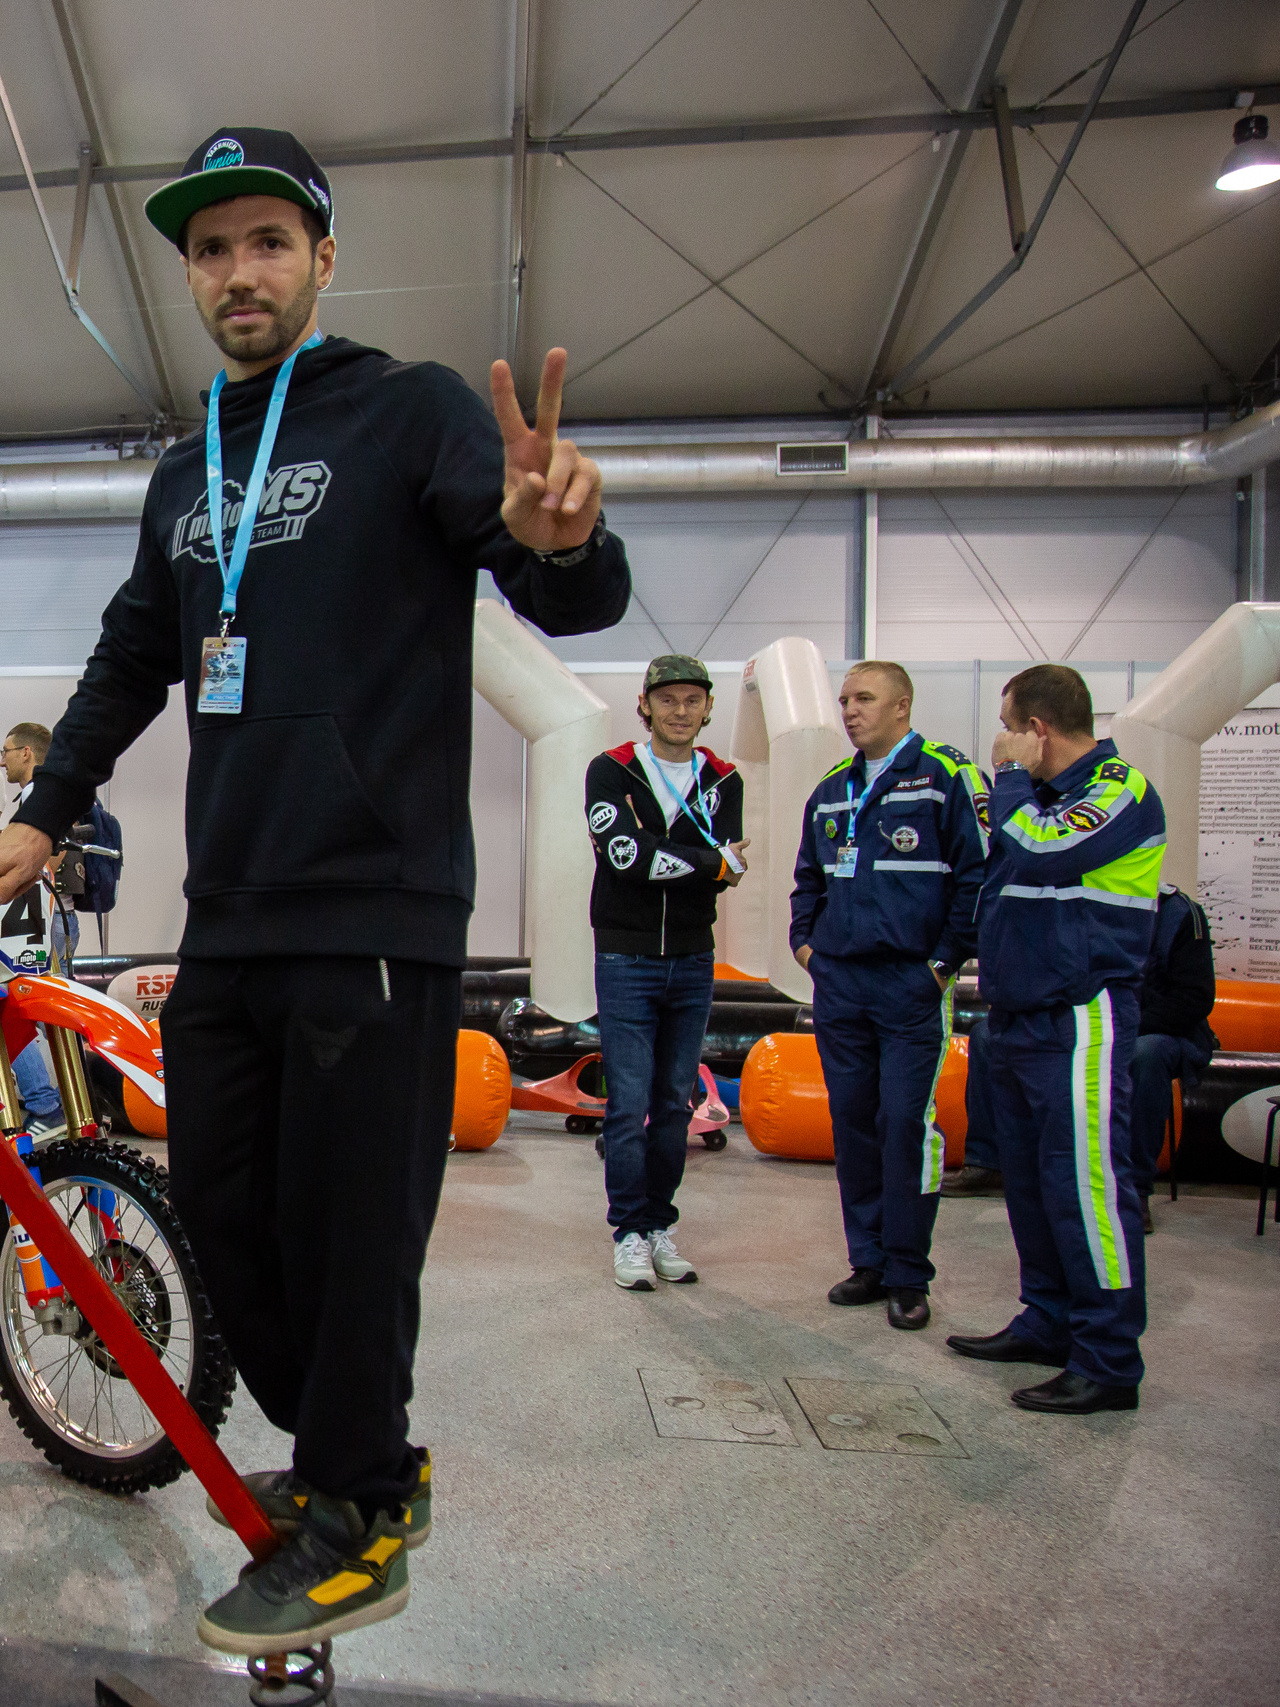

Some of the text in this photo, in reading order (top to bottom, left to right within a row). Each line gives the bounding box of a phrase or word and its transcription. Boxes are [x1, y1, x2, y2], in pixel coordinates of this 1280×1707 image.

[257, 525, 282, 538] TEAM
[1217, 723, 1280, 736] w.mot
[592, 807, 613, 826] Gulf
[0, 880, 47, 947] 4
